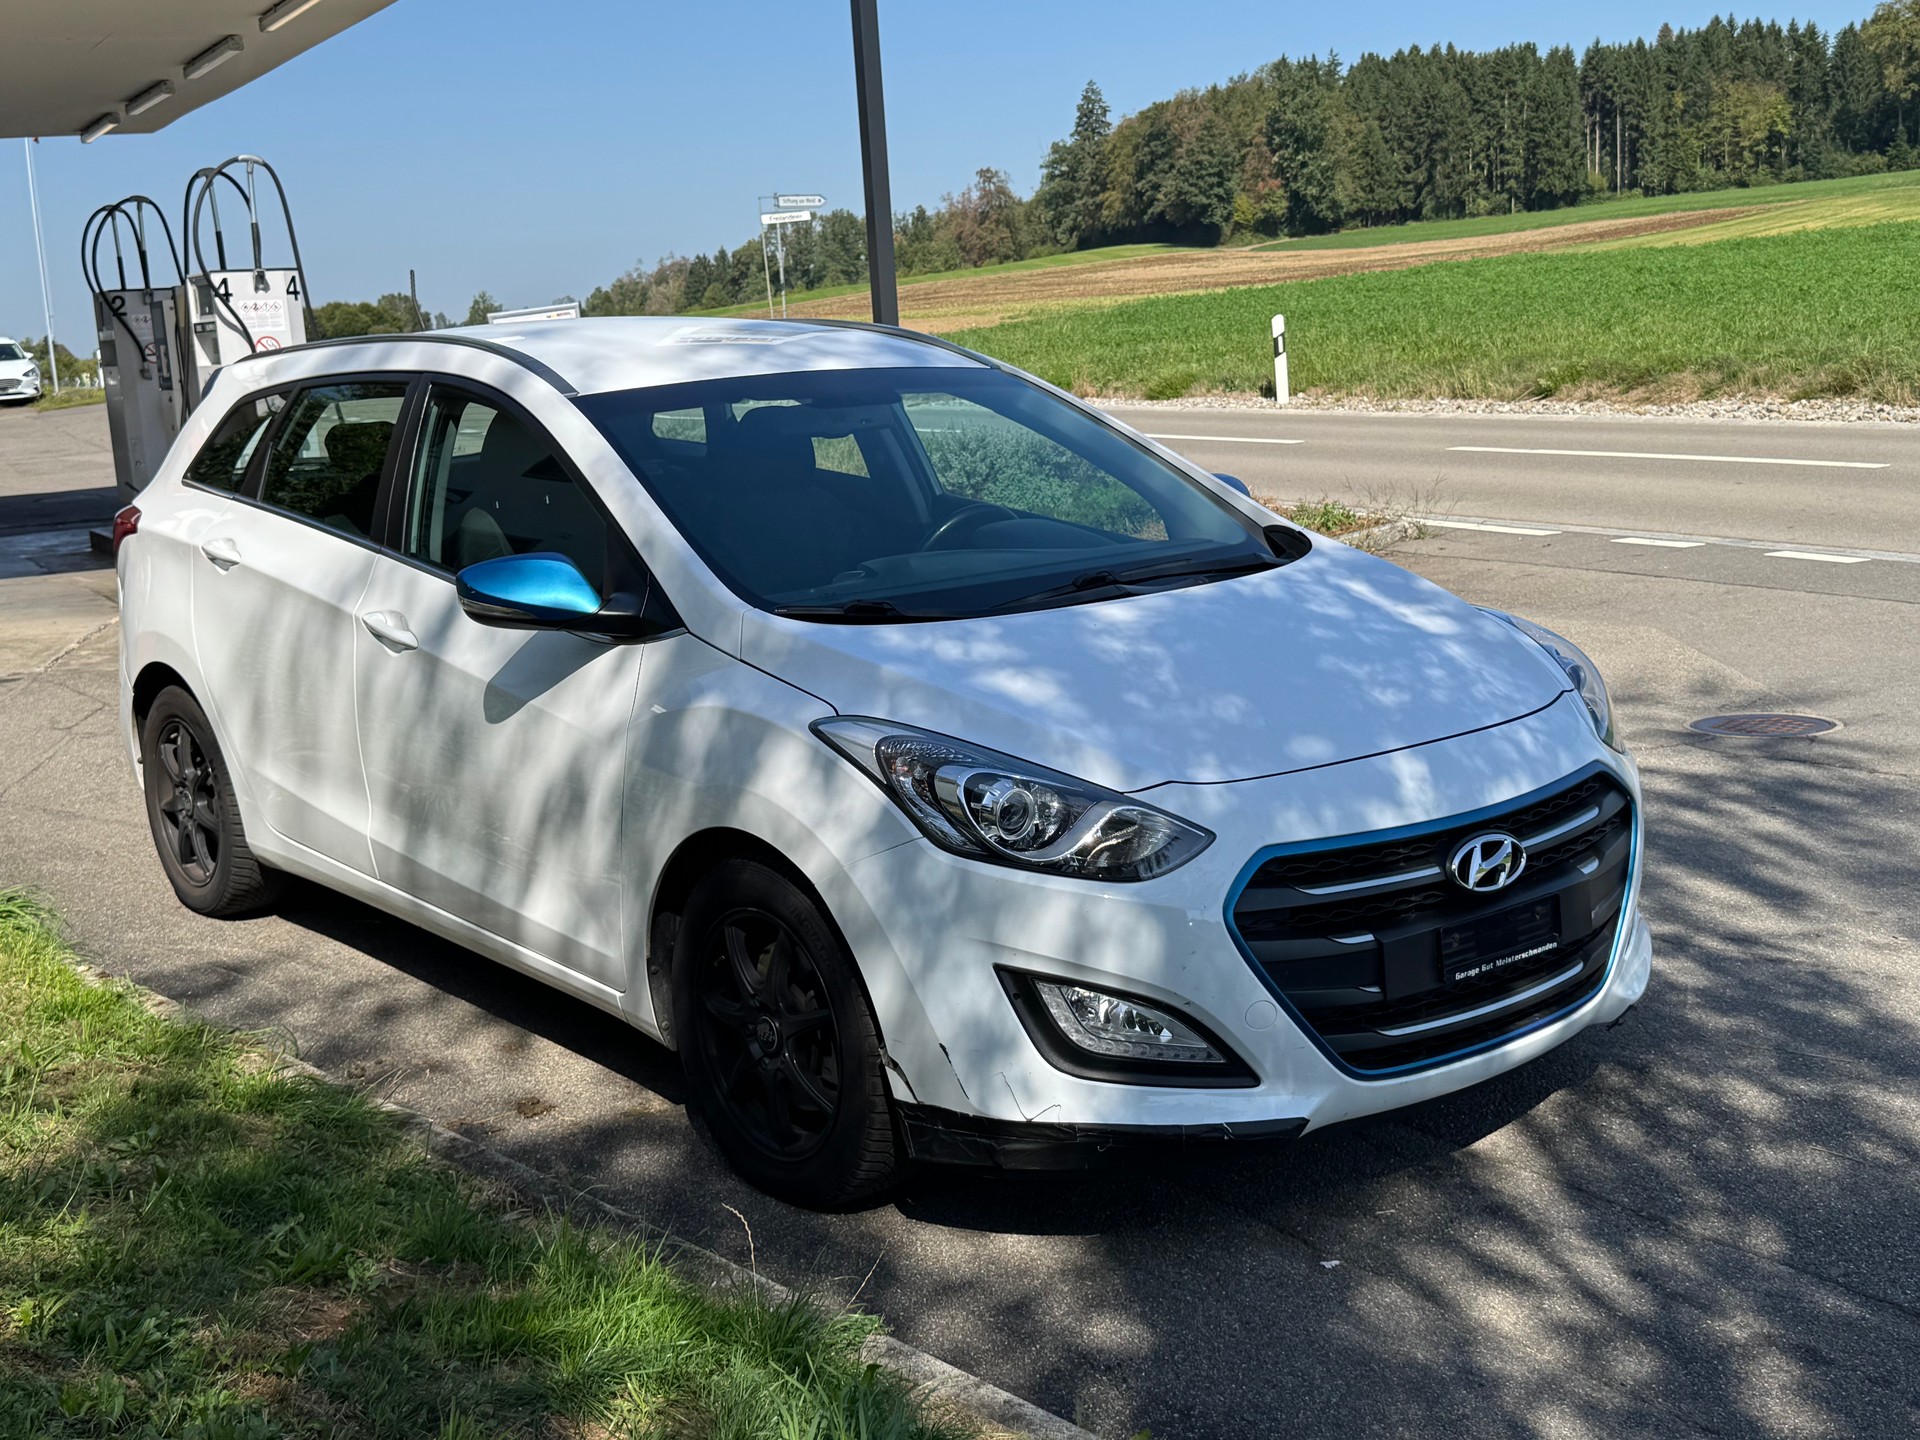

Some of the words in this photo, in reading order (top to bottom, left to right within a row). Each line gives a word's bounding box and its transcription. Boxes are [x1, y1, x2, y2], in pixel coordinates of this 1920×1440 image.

[215, 277, 233, 303] 4
[286, 275, 300, 301] 4
[111, 295, 127, 317] 2
[1455, 967, 1479, 980] Garage
[1481, 962, 1494, 972] Gut
[1495, 941, 1557, 967] Meisterschwanden
